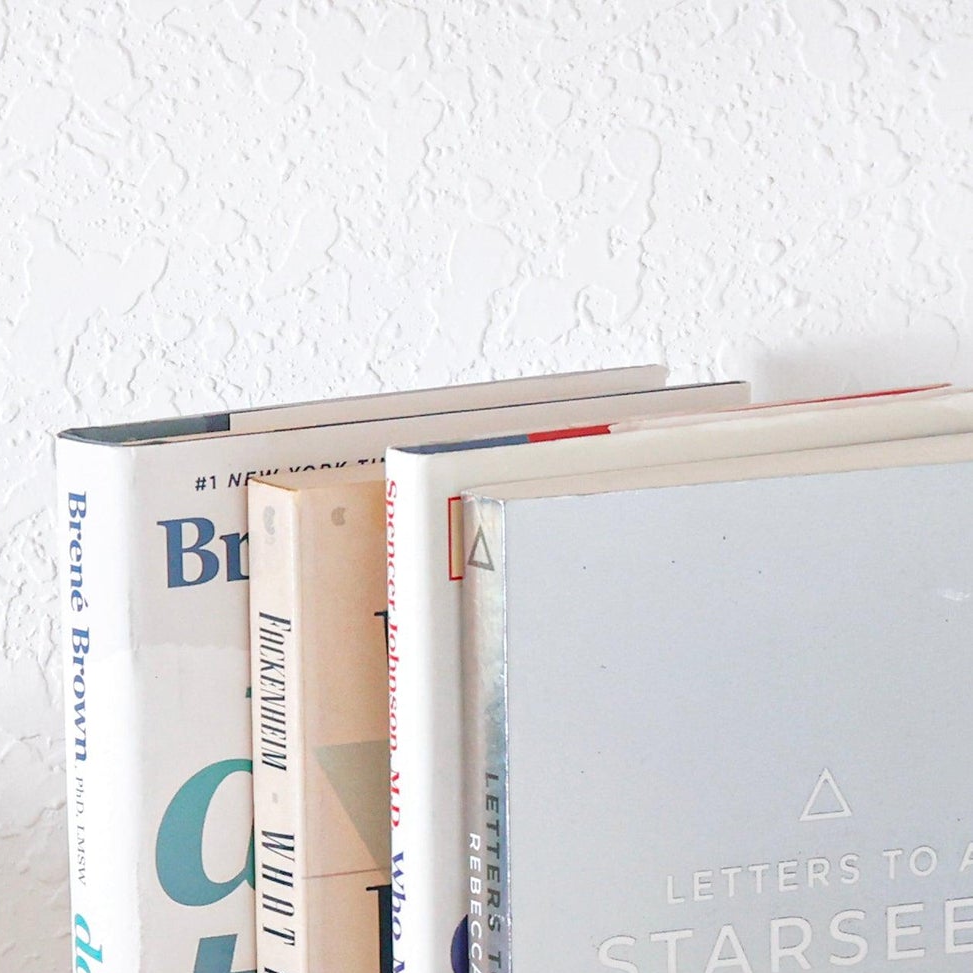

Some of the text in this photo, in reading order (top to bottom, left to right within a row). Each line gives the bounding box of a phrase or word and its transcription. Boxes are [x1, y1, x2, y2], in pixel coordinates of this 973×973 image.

[195, 475, 218, 492] #1
[68, 491, 89, 612] Brené
[387, 478, 398, 611] Spencer
[261, 829, 296, 946] WHAT
[392, 851, 407, 941] Who
[484, 771, 501, 933] LETTERS
[666, 854, 861, 905] LETTERS
[882, 845, 938, 880] TO
